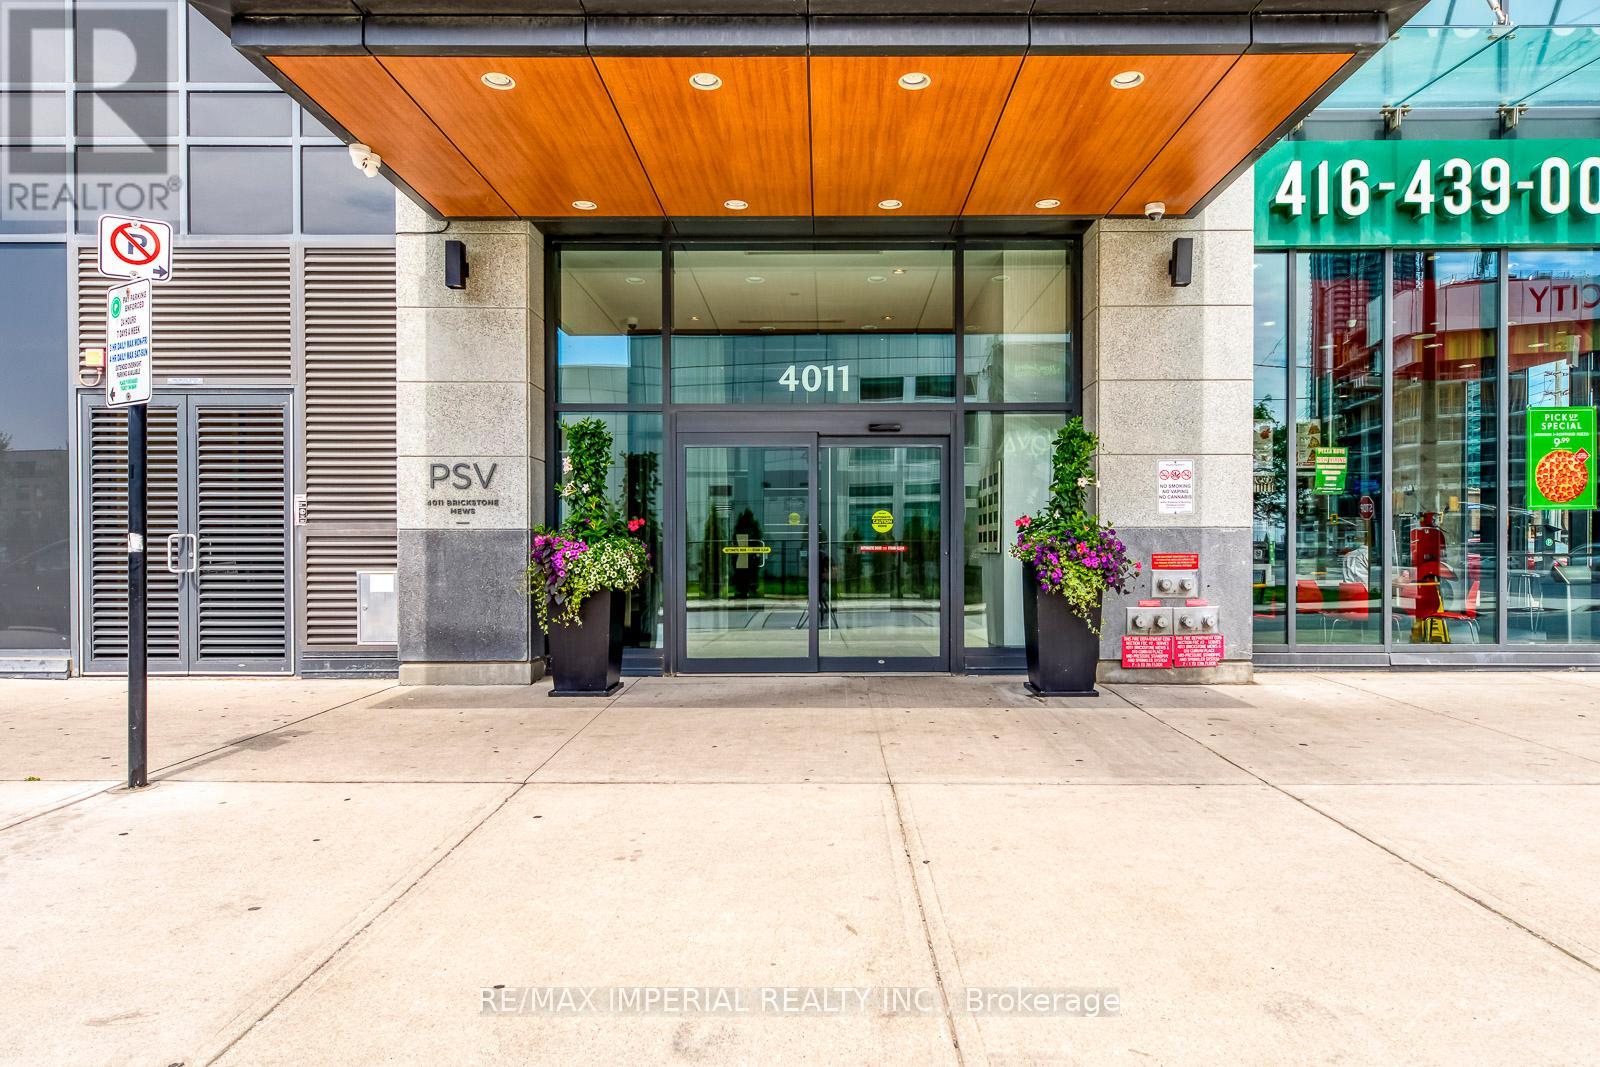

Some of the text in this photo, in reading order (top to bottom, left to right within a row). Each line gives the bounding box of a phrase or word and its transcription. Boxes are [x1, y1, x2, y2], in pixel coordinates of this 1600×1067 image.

[778, 364, 849, 392] 4011
[1544, 413, 1568, 421] PICK
[1541, 422, 1582, 430] SPECIAL
[429, 463, 497, 490] PSV
[446, 499, 500, 507] BRICKSTONE
